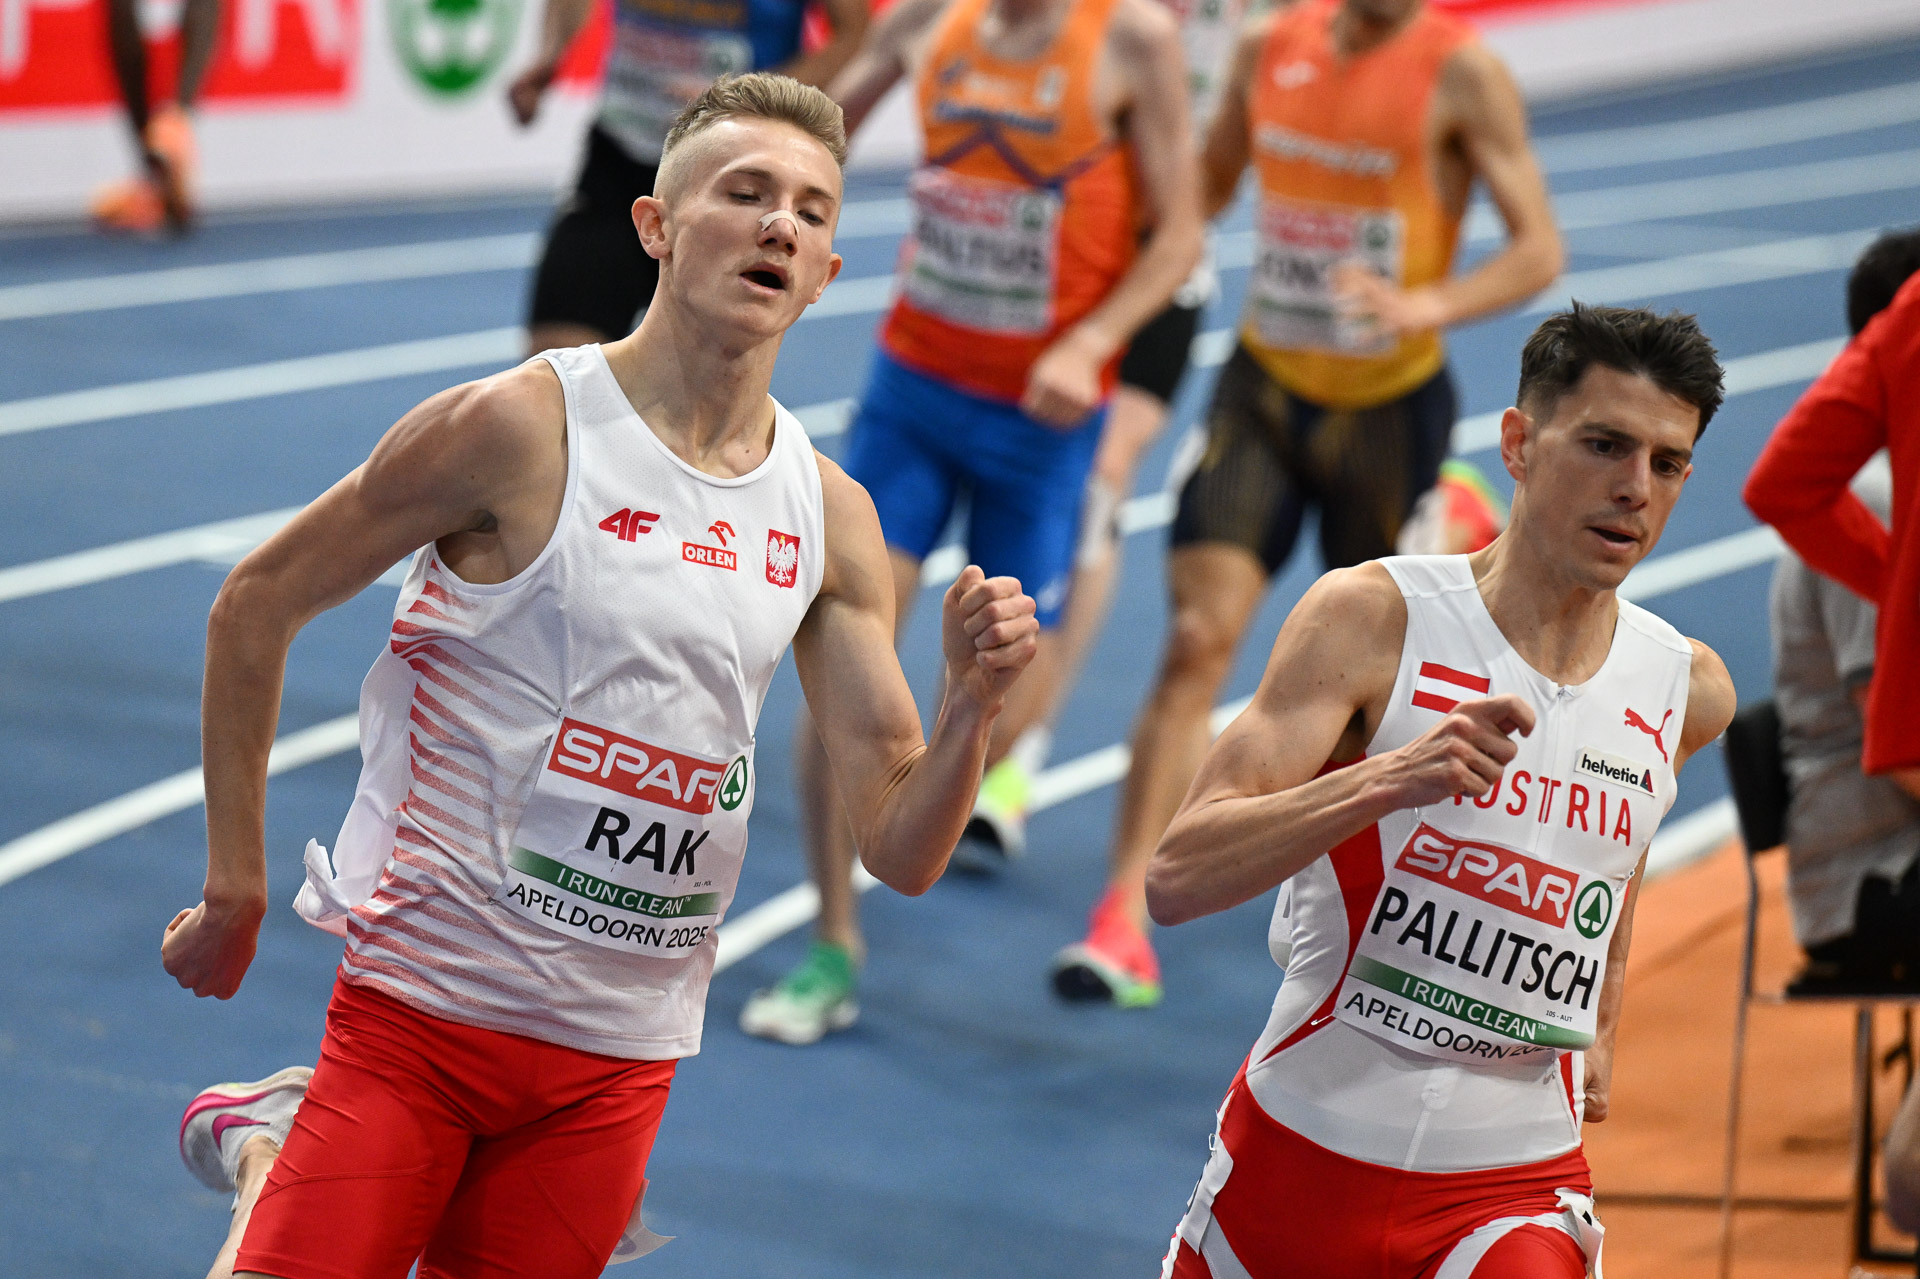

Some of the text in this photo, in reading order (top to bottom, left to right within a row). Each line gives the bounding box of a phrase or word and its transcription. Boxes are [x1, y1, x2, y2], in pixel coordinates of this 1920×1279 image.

[598, 507, 661, 543] 4F
[684, 545, 734, 569] ORLEN
[556, 728, 723, 806] SPAR
[1581, 753, 1639, 786] helvetia
[584, 807, 711, 876] RAK
[1453, 770, 1631, 847] USTRIA
[556, 867, 566, 884] I
[567, 873, 615, 903] RUN
[1404, 832, 1573, 919] SPAR
[507, 882, 709, 949] APELDOORN 2025
[1369, 885, 1599, 1011] PALLITSCH
[1344, 991, 1511, 1060] APELDOORN
[1401, 976, 1412, 995] I
[1413, 980, 1464, 1016] RUN
[1559, 1014, 1573, 1023] AUT
